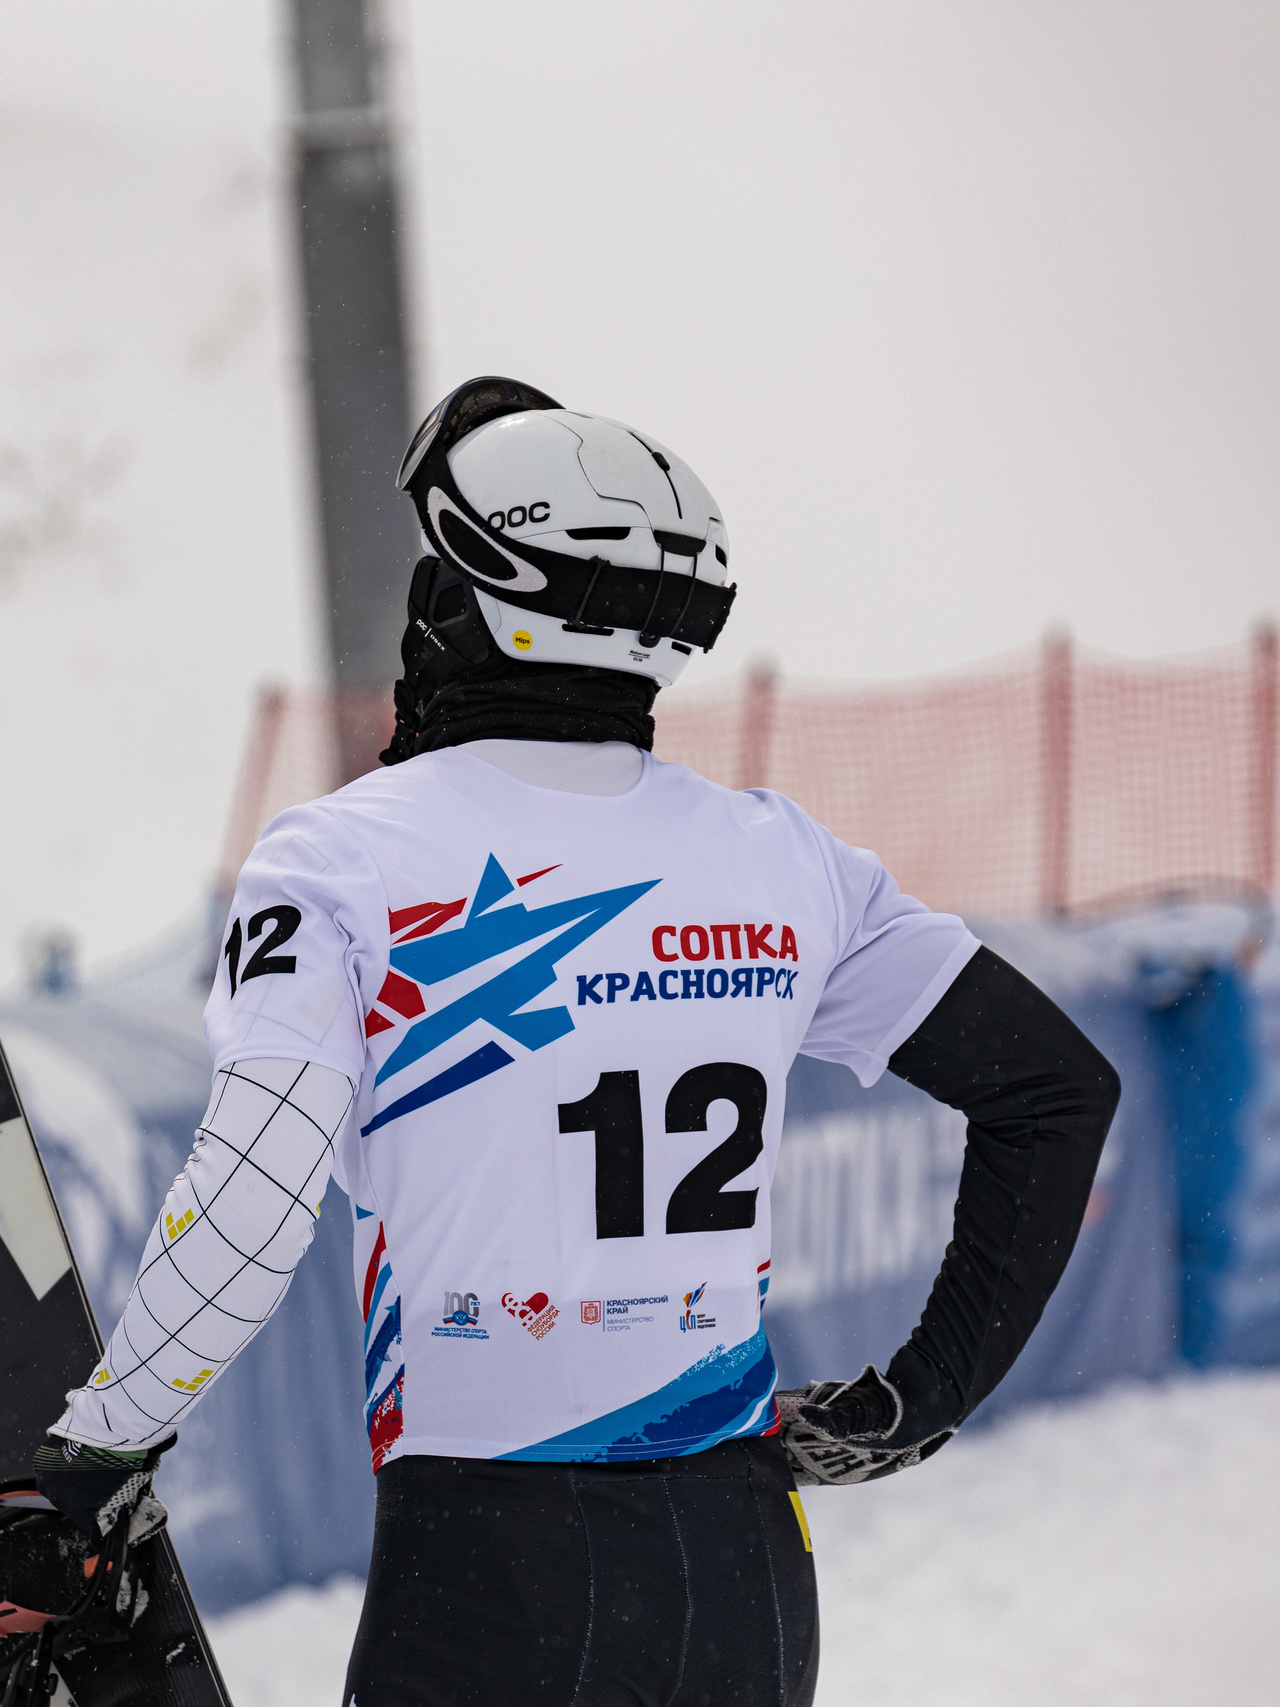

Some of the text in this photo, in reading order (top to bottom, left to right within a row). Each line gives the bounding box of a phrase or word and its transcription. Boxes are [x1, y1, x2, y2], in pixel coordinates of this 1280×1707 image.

[515, 636, 531, 645] Mips
[225, 905, 302, 1001] 12
[652, 924, 799, 963] СОПКА
[576, 967, 799, 1006] КРАСНОЯРСК
[558, 1062, 767, 1240] 12
[606, 1295, 669, 1307] КРАСНОЯРСКИЙ
[606, 1306, 629, 1315] КРАЙ
[527, 1304, 556, 1333] ФЕДЕРАЦИЯ
[531, 1309, 561, 1337] СНОУБОРДА
[535, 1321, 557, 1341] РОССИИ
[606, 1316, 654, 1325] МИНИСТЕРСТВО
